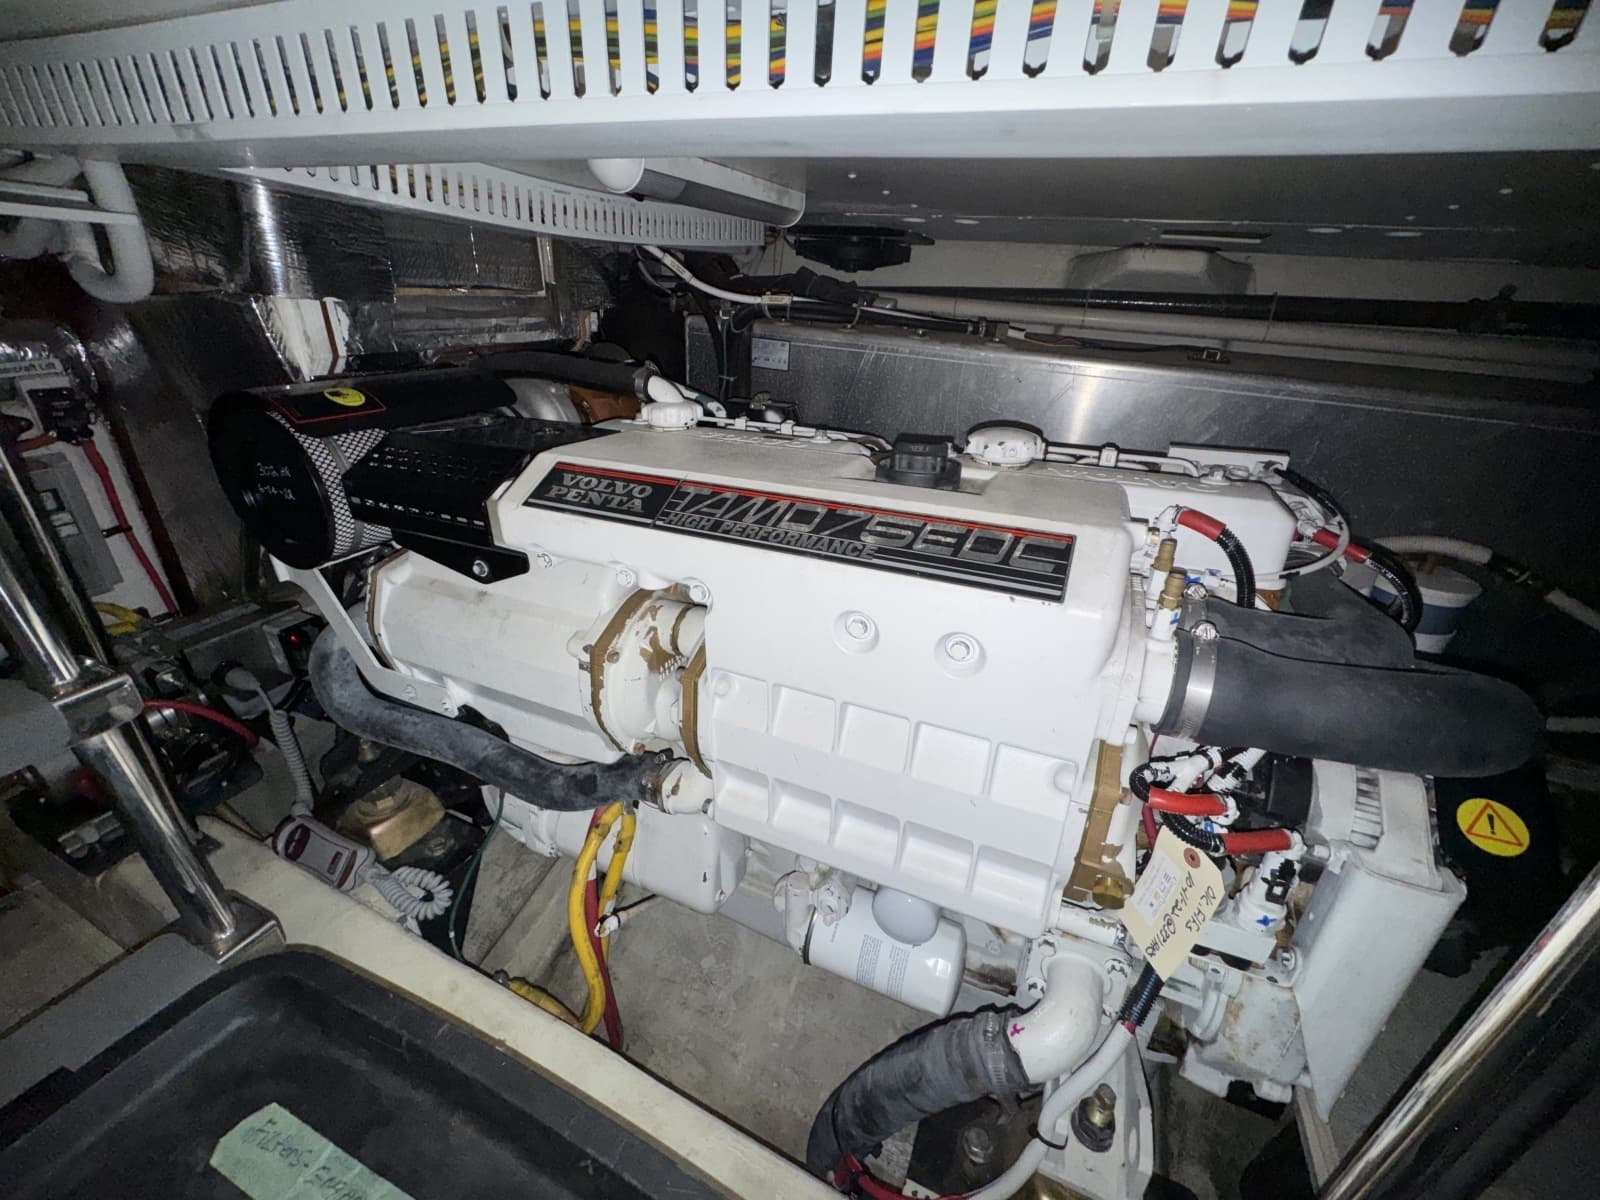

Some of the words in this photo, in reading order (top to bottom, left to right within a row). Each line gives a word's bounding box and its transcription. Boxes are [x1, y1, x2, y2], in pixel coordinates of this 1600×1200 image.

[547, 485, 645, 513] PENTA
[560, 473, 653, 498] VOLVO
[663, 511, 714, 531] HIGH
[718, 519, 882, 560] PERFORMANCE
